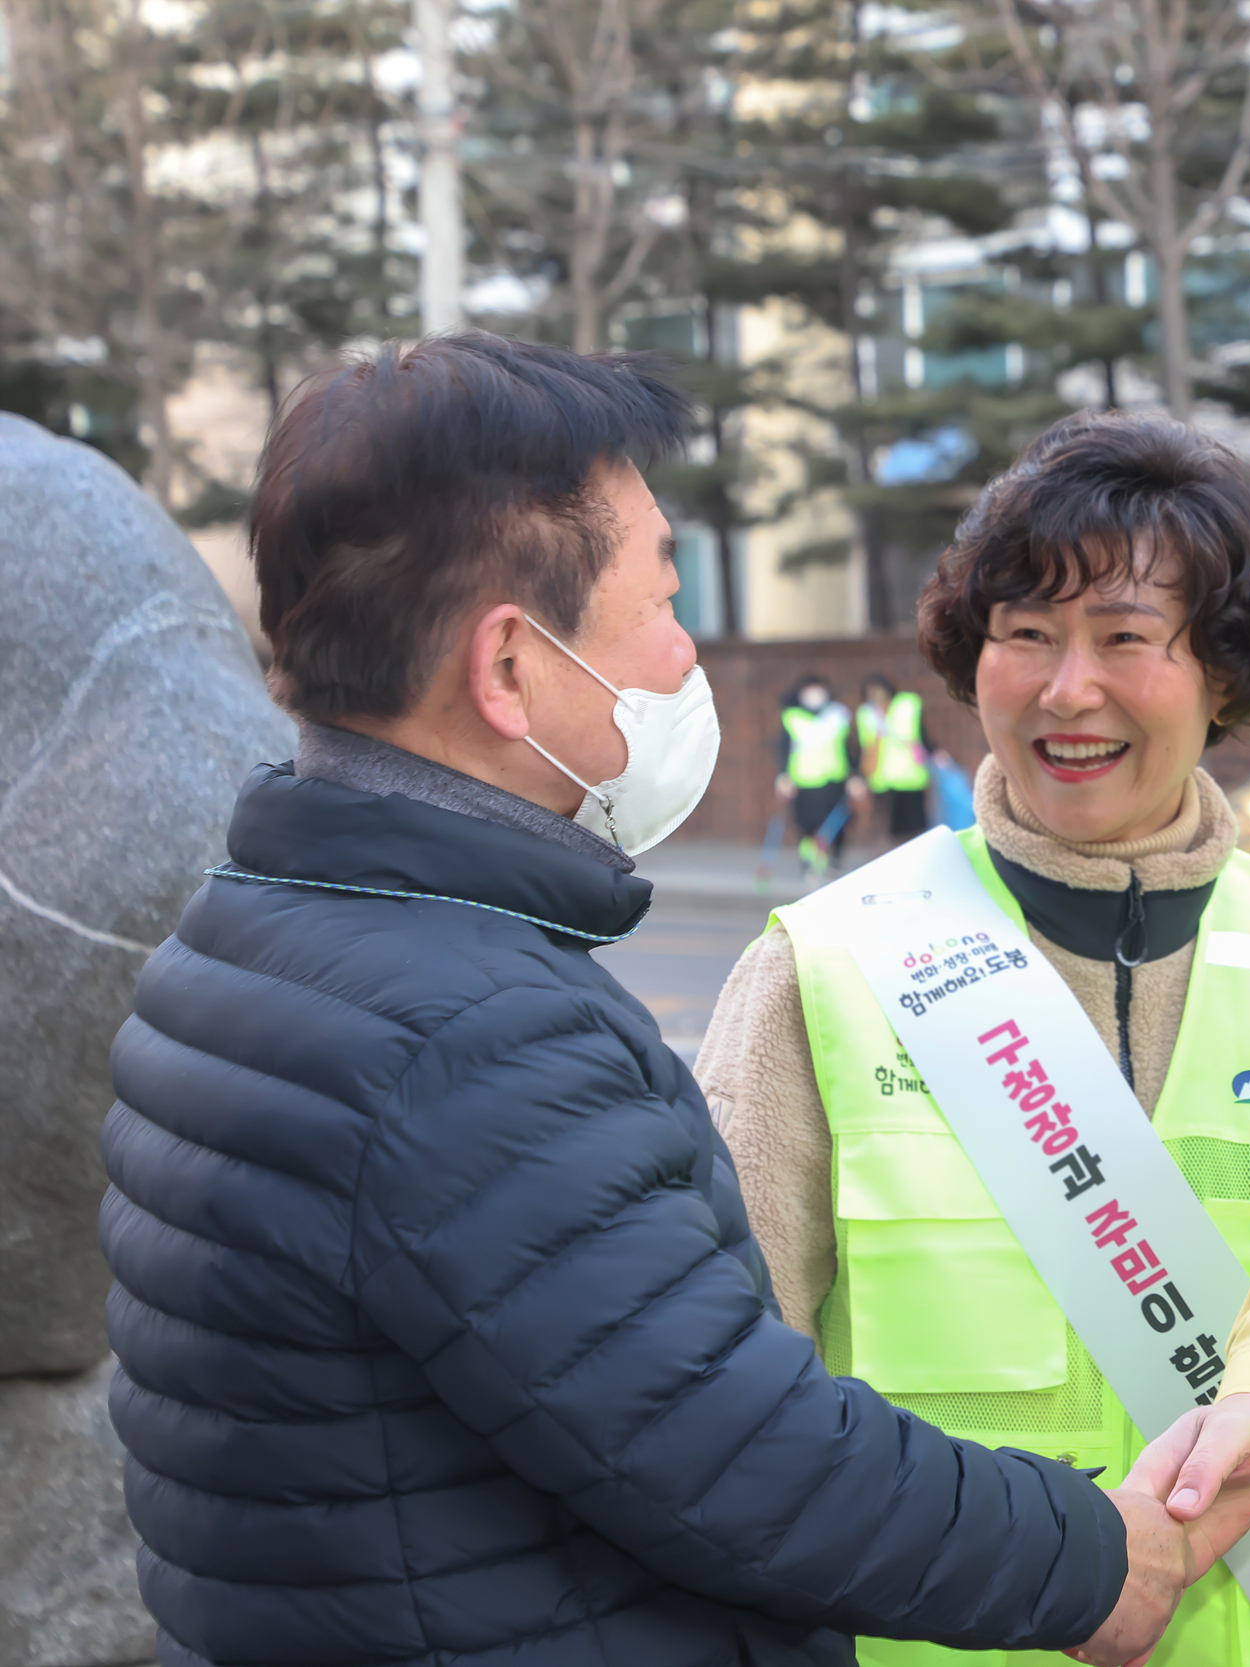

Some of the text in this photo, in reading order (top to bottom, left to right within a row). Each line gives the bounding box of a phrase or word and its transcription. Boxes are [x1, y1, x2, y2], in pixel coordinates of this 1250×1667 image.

[904, 932, 990, 968] dobong
[985, 948, 1028, 975] 도봉
[977, 1018, 1105, 1202] 구청장과
[1085, 1198, 1194, 1333] 주민이
